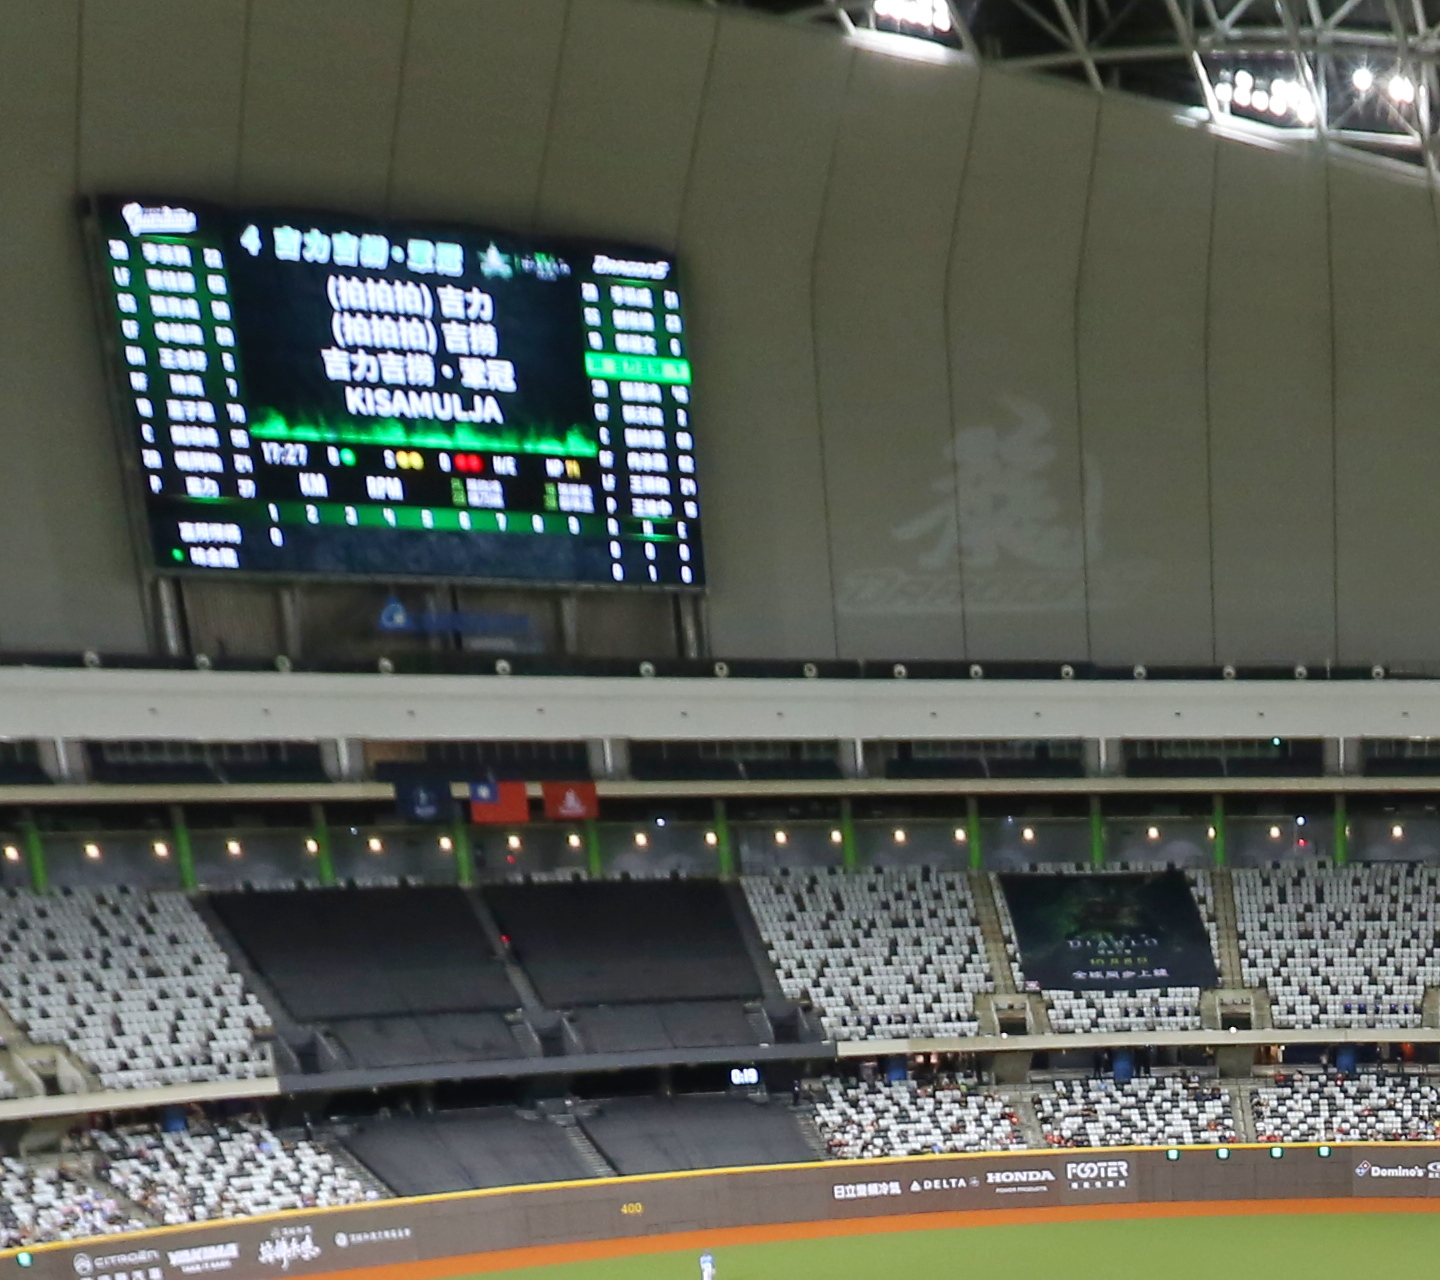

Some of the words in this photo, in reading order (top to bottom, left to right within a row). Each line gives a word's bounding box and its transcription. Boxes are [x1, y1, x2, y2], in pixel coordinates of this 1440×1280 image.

[240, 225, 261, 256] 4
[437, 284, 495, 322] 吉力
[345, 386, 504, 424] KISAMULJA
[261, 442, 308, 466] 17:27
[268, 503, 279, 522] 1
[306, 504, 319, 524] 2
[731, 1068, 759, 1085] 0:19
[985, 1170, 1056, 1184] HONDA
[1066, 1161, 1129, 1180] FOOTER
[1371, 1166, 1424, 1178] Domino's
[923, 1178, 967, 1190] DELTA
[167, 1242, 240, 1266] YAKIMA
